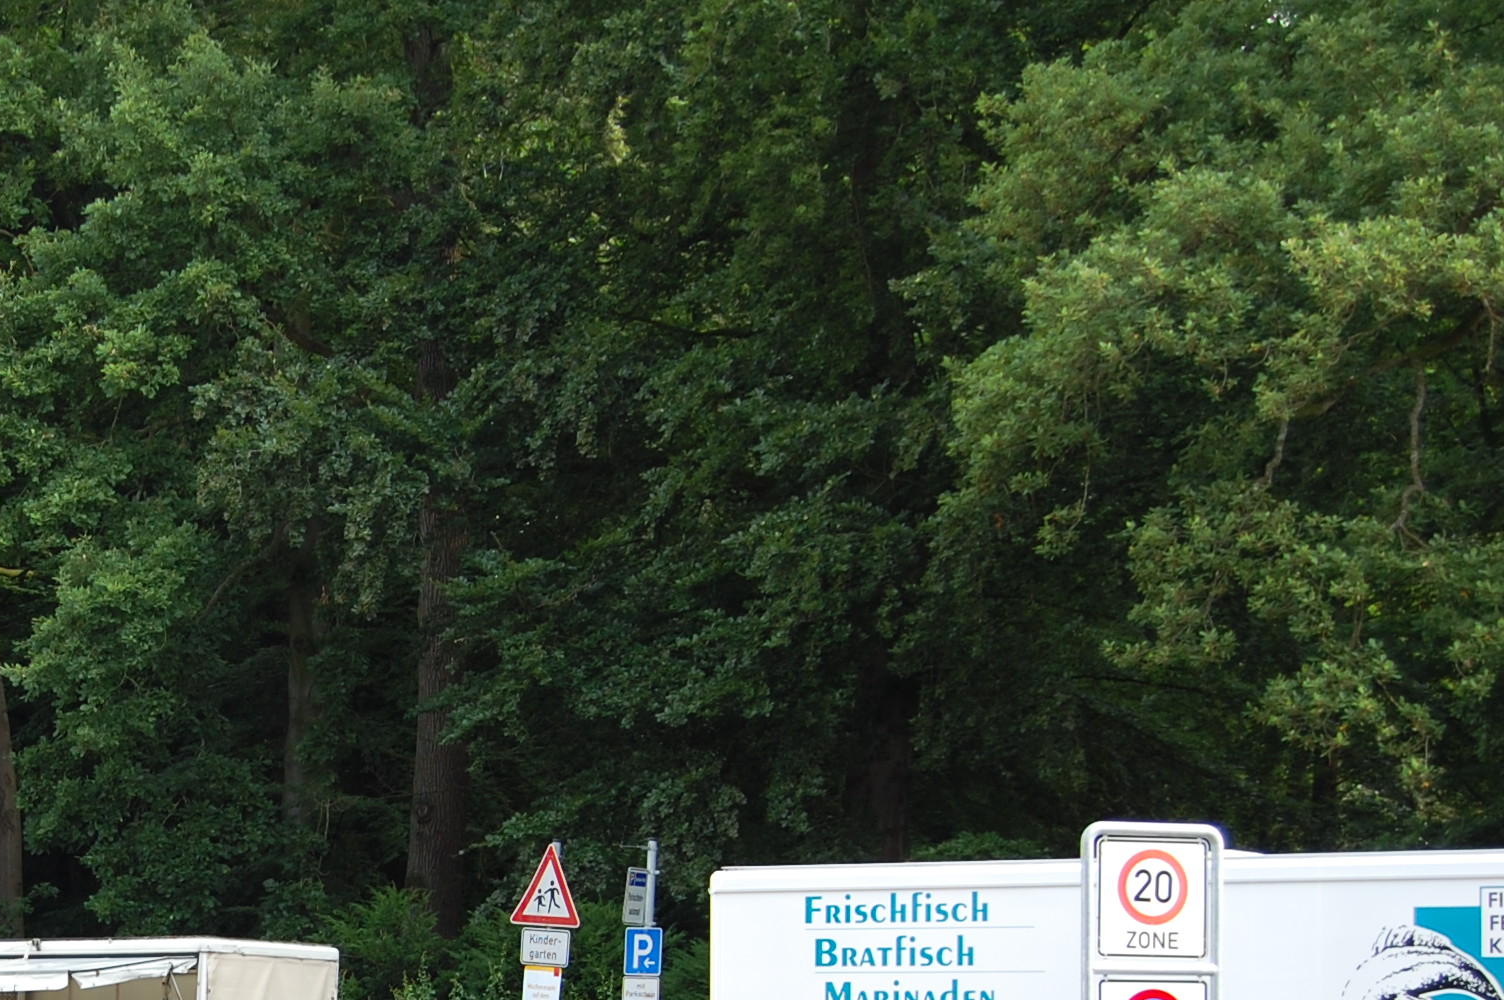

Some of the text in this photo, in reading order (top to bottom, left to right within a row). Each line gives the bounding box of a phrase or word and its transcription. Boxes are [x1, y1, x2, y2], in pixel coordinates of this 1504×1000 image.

[1134, 869, 1173, 903] 20
[804, 891, 988, 924] Frischfisch
[529, 933, 562, 946] Kinder-
[814, 935, 974, 967] Bratfisch
[1126, 931, 1179, 949] ZONE
[529, 950, 557, 961] garten
